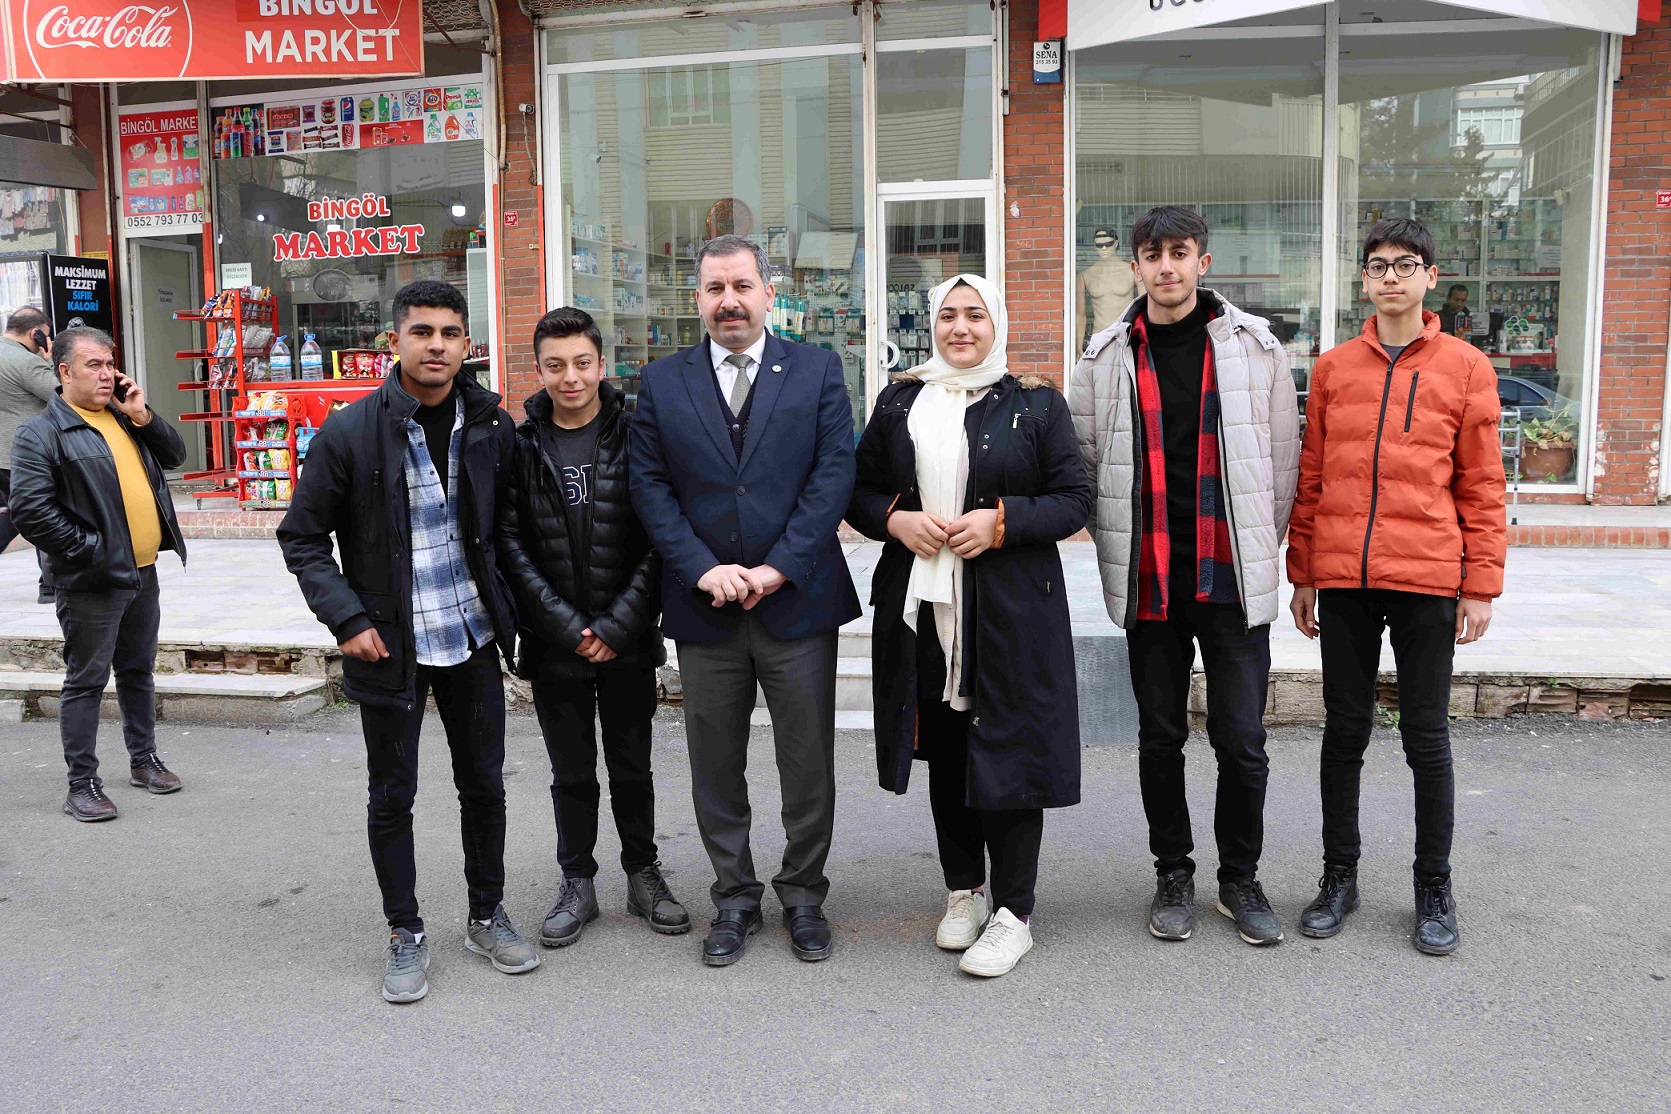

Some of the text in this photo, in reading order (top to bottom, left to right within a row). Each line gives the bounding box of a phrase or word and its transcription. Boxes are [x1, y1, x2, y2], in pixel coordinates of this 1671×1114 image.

[36, 5, 179, 49] Coca-Cola
[245, 28, 400, 64] MARKET
[1036, 51, 1057, 59] SENA
[120, 115, 199, 135] BİNGÖL MARKE
[307, 192, 391, 222] BİNGÖL
[127, 215, 152, 228] 0552
[155, 214, 174, 226] 793
[176, 213, 188, 225] 77
[272, 223, 425, 262] MARKET
[54, 264, 107, 280] MAKSİMUM
[65, 279, 97, 291] LEZZET
[72, 290, 93, 301] SIFIR
[67, 300, 99, 312] KALORİ
